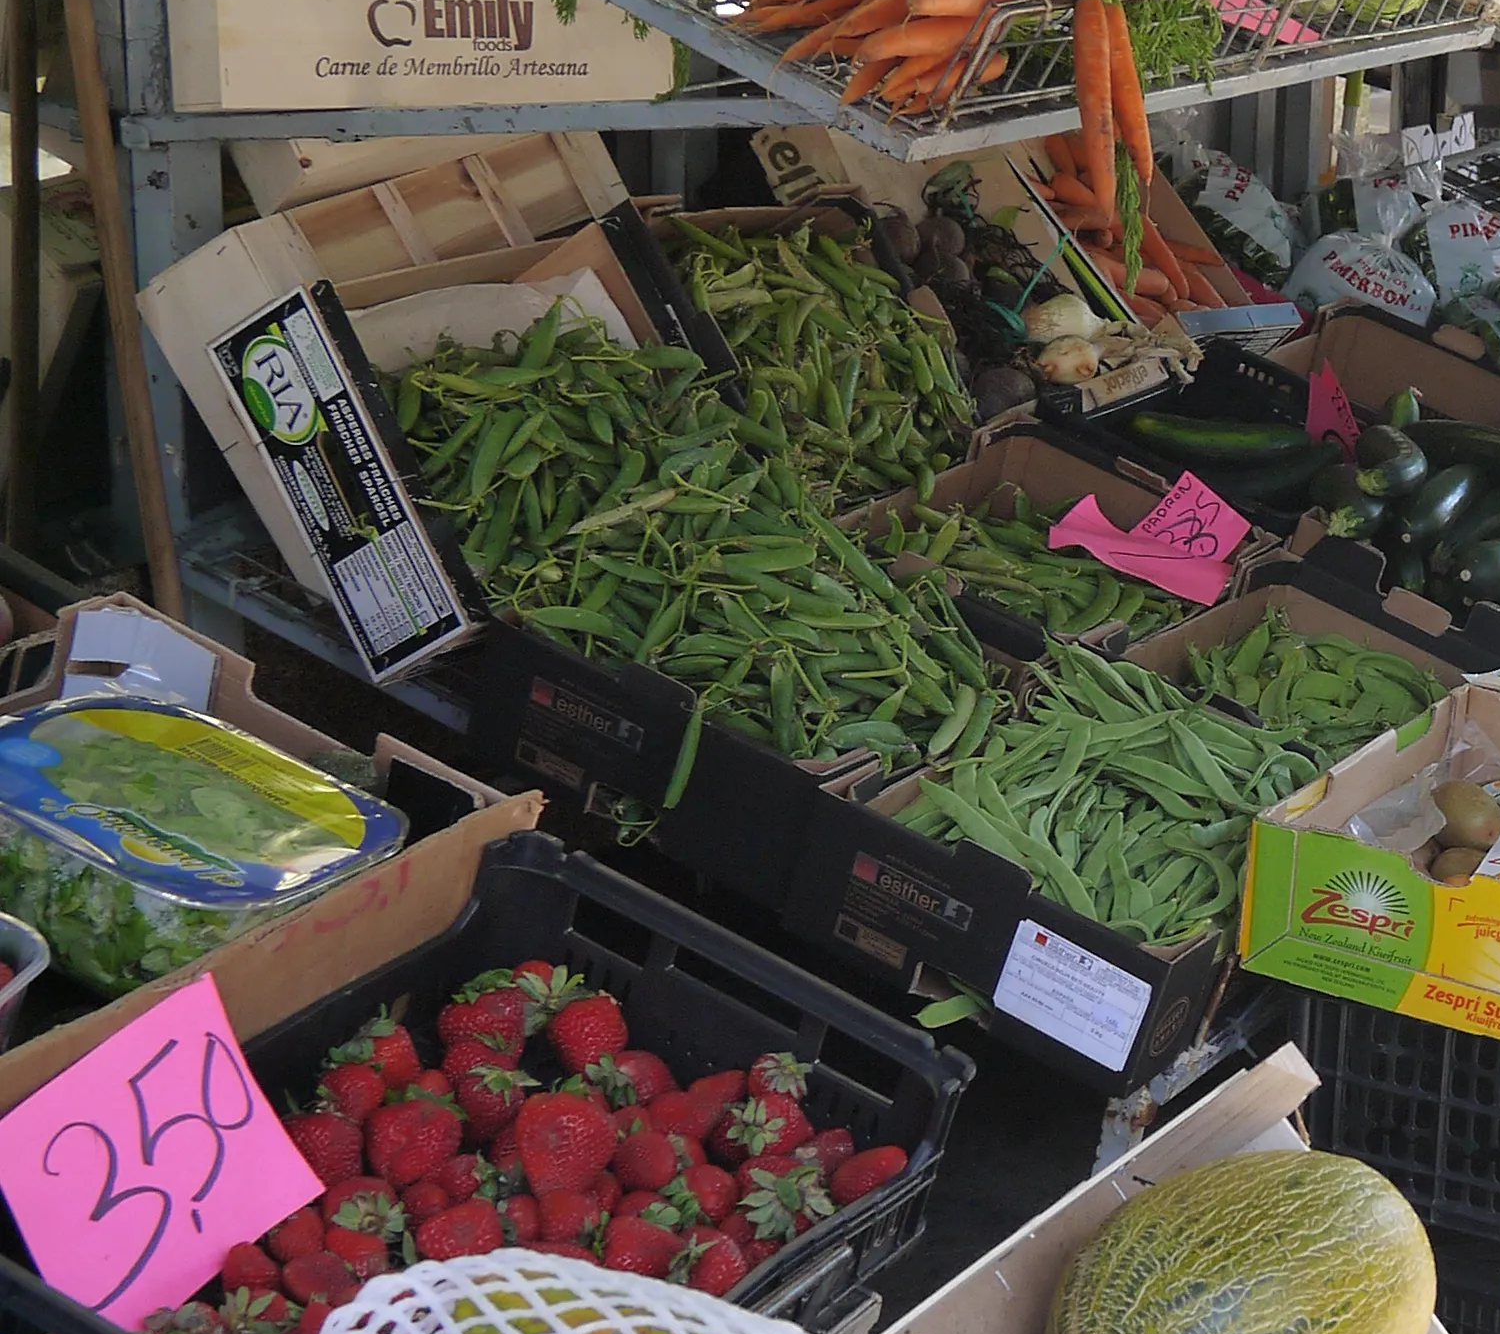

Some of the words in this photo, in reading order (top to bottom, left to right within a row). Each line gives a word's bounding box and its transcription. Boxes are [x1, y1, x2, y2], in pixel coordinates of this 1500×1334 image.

[472, 37, 513, 52] foods
[316, 56, 370, 77] Carne
[376, 55, 399, 77] de
[403, 54, 501, 77] Membrillo
[503, 56, 590, 79] Artesana
[254, 348, 304, 433] RIA
[337, 398, 374, 461] ASPERGES
[327, 403, 362, 466] FRISCHER
[358, 470, 390, 528] SPARGEL
[556, 696, 613, 734] esther
[879, 872, 941, 914] esther
[1301, 888, 1415, 941] Zespri
[1300, 926, 1319, 943] New
[1320, 930, 1367, 956] Zealand
[1368, 941, 1413, 966] Kiwifruit
[1312, 951, 1372, 974] www.zespri.com
[1424, 984, 1482, 1016] Zespri
